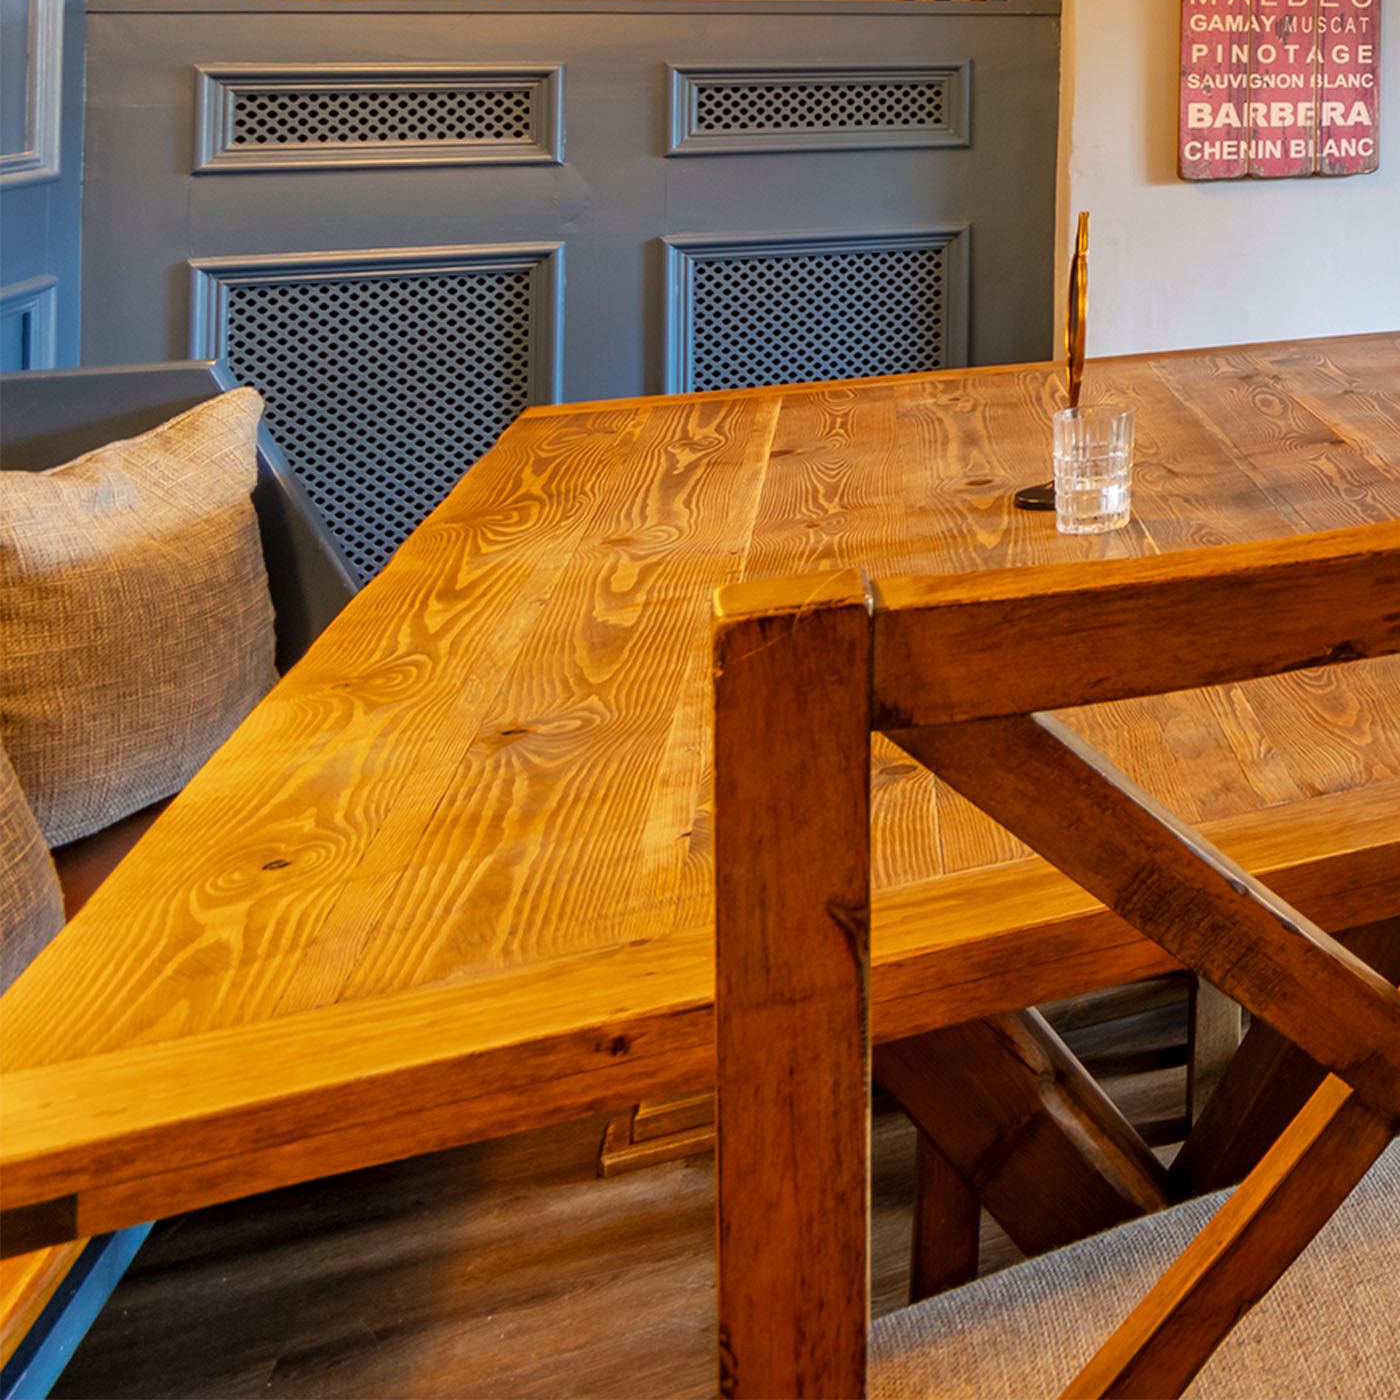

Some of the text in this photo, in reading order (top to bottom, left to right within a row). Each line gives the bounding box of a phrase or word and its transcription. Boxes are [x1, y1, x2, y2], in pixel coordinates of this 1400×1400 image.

[1189, 14, 1370, 34] GAMAY MUSCAT
[1191, 44, 1373, 64] PINOTAGE
[1187, 73, 1374, 89] SAUVIGNON BLANC
[1187, 101, 1373, 129] BARBERA
[1183, 138, 1374, 161] CHENIN BLANC
